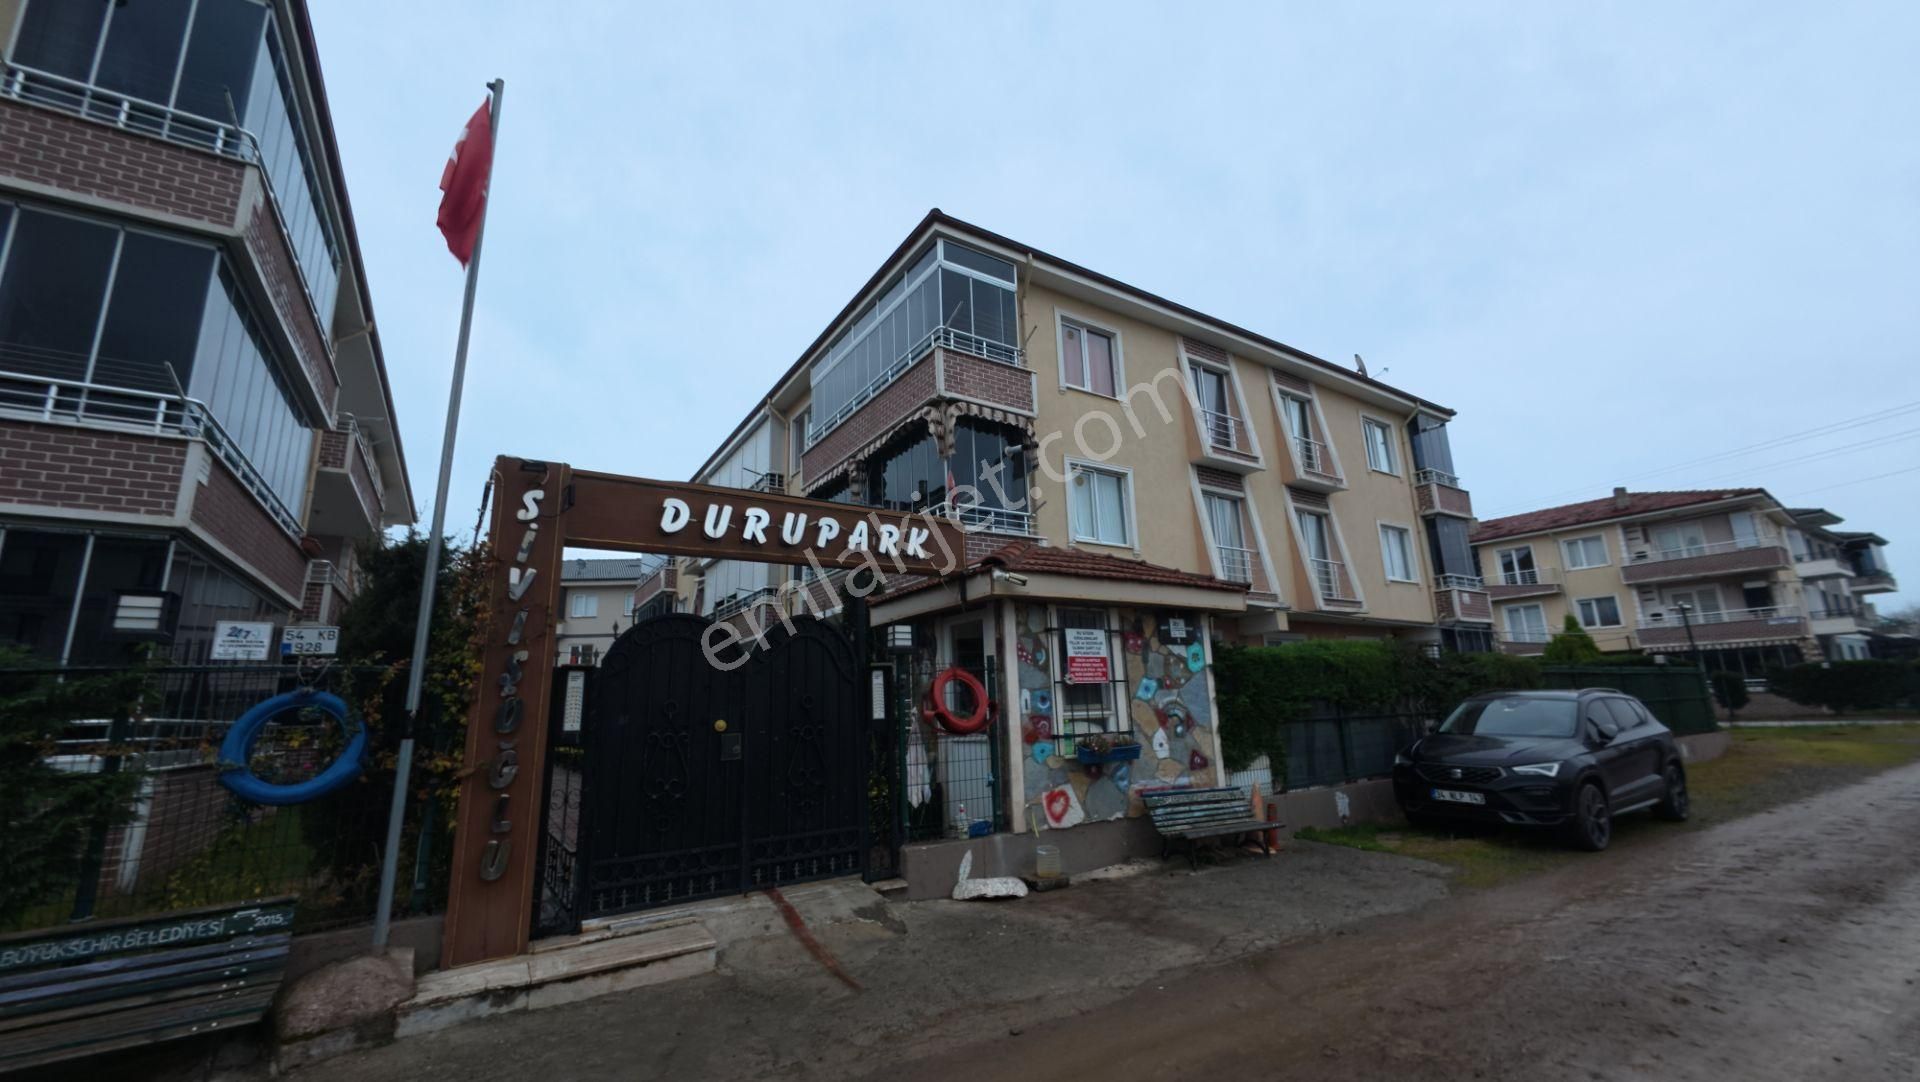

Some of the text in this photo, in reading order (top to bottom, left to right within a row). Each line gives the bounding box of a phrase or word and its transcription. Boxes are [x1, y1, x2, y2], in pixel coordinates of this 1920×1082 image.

[659, 498, 929, 559] DURUPARK
[285, 630, 337, 641] 54 KB
[294, 642, 323, 653] 928
[254, 914, 284, 928] 2015
